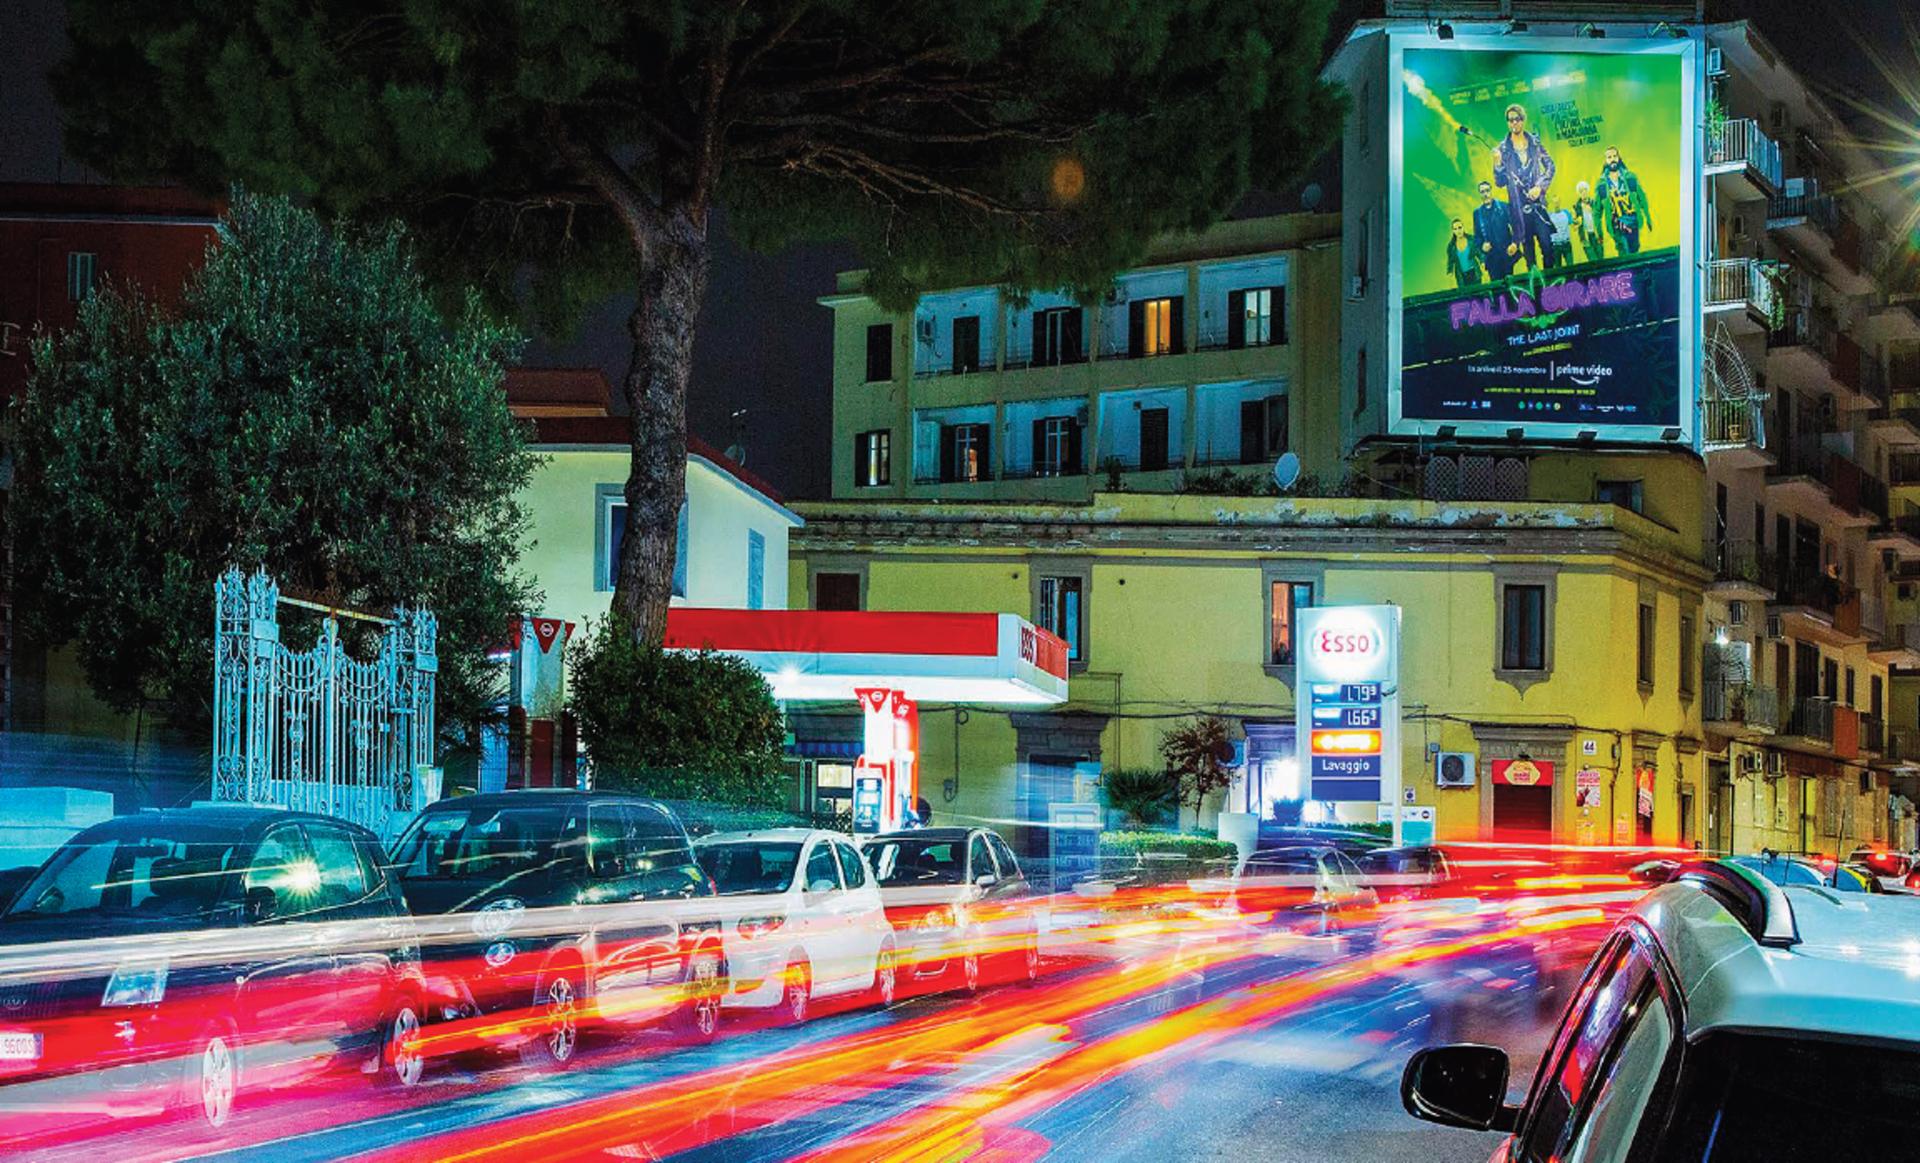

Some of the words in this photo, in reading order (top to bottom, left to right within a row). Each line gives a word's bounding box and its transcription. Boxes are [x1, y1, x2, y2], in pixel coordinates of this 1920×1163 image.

[1450, 293, 1535, 330] FALLA
[1541, 272, 1635, 312] GIRARE
[1507, 335, 1526, 346] THE
[1528, 330, 1553, 344] LAST
[1554, 324, 1581, 341] JOINT
[1503, 366, 1512, 374] 25
[1513, 366, 1547, 374] novembre
[1556, 363, 1584, 376] prime
[1586, 364, 1612, 376] video
[1584, 742, 1594, 751] 44
[1322, 759, 1370, 774] Lavaggio
